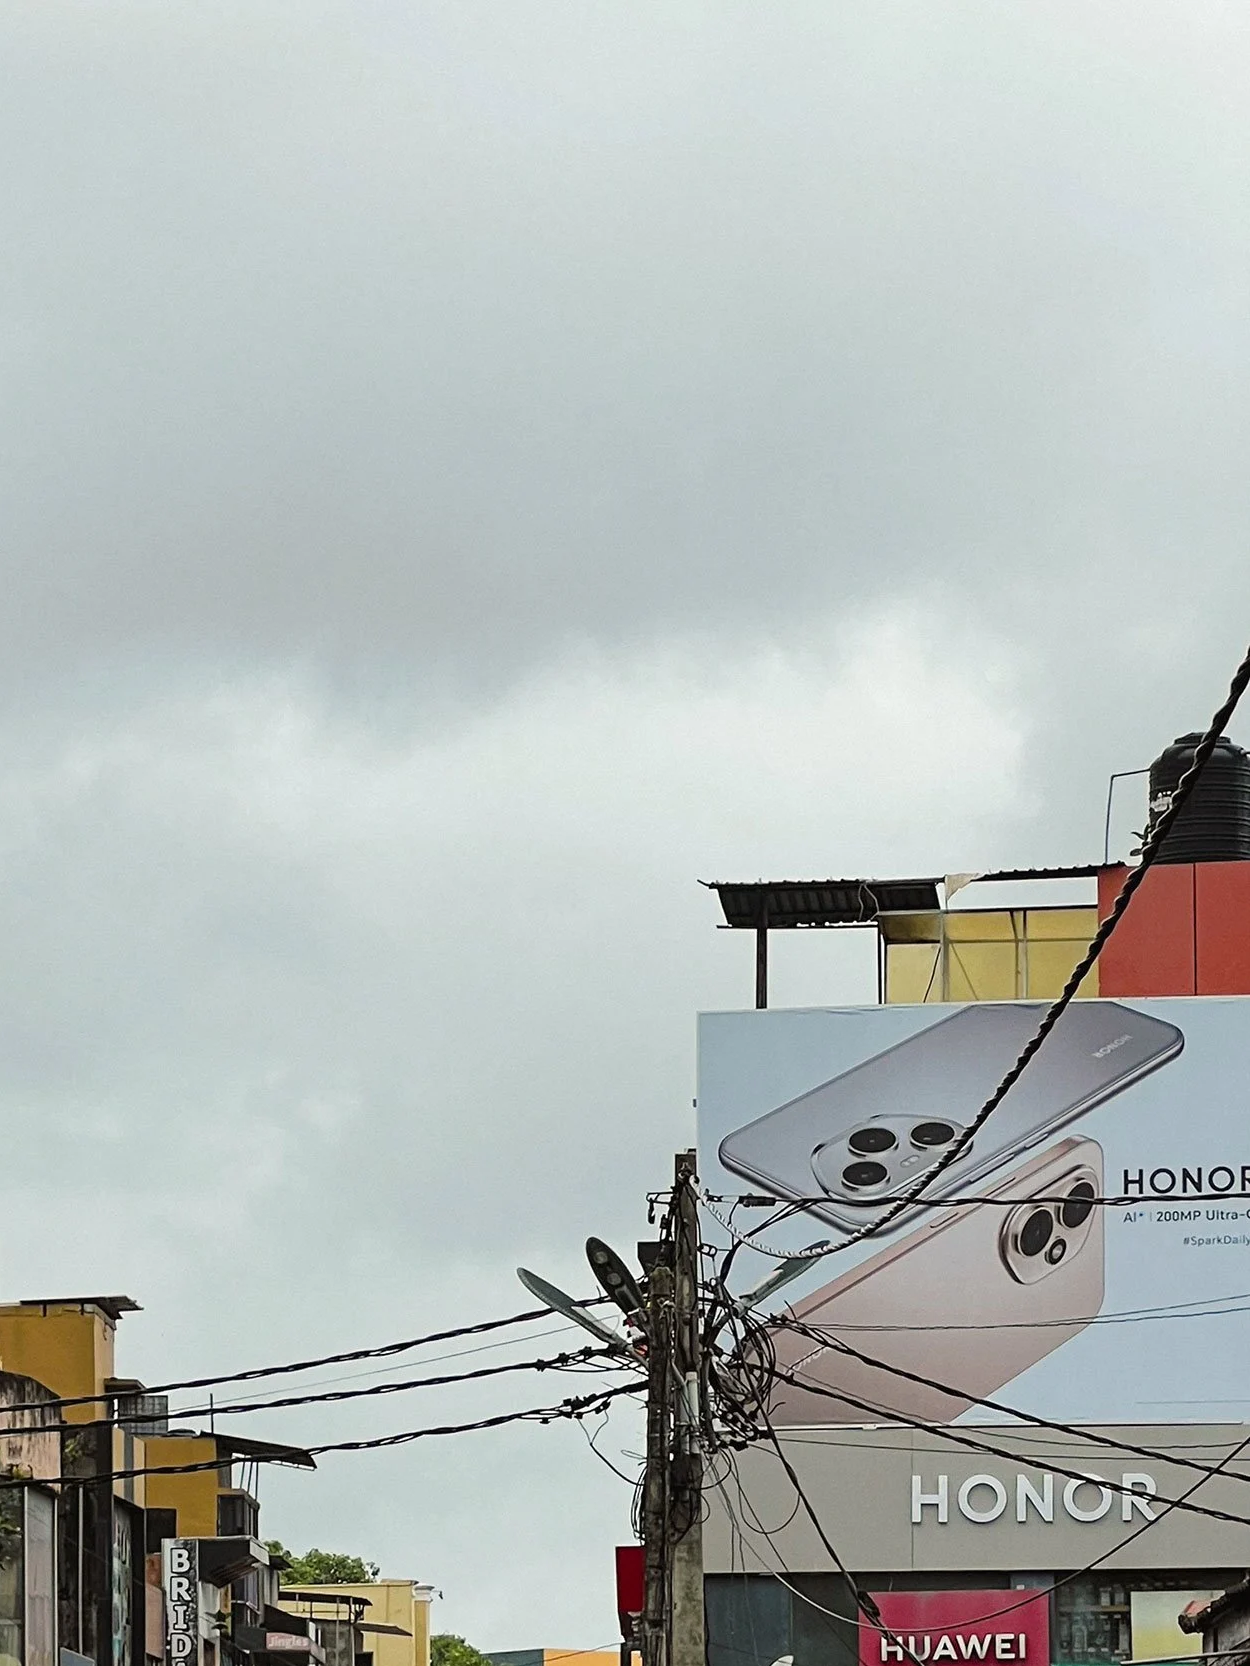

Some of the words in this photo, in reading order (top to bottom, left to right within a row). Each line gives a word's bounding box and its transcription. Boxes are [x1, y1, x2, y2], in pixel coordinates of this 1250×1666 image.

[1156, 1211, 1201, 1222] 200MP
[911, 1473, 1161, 1523] HONOR
[880, 1632, 1027, 1662] HUAWEI
